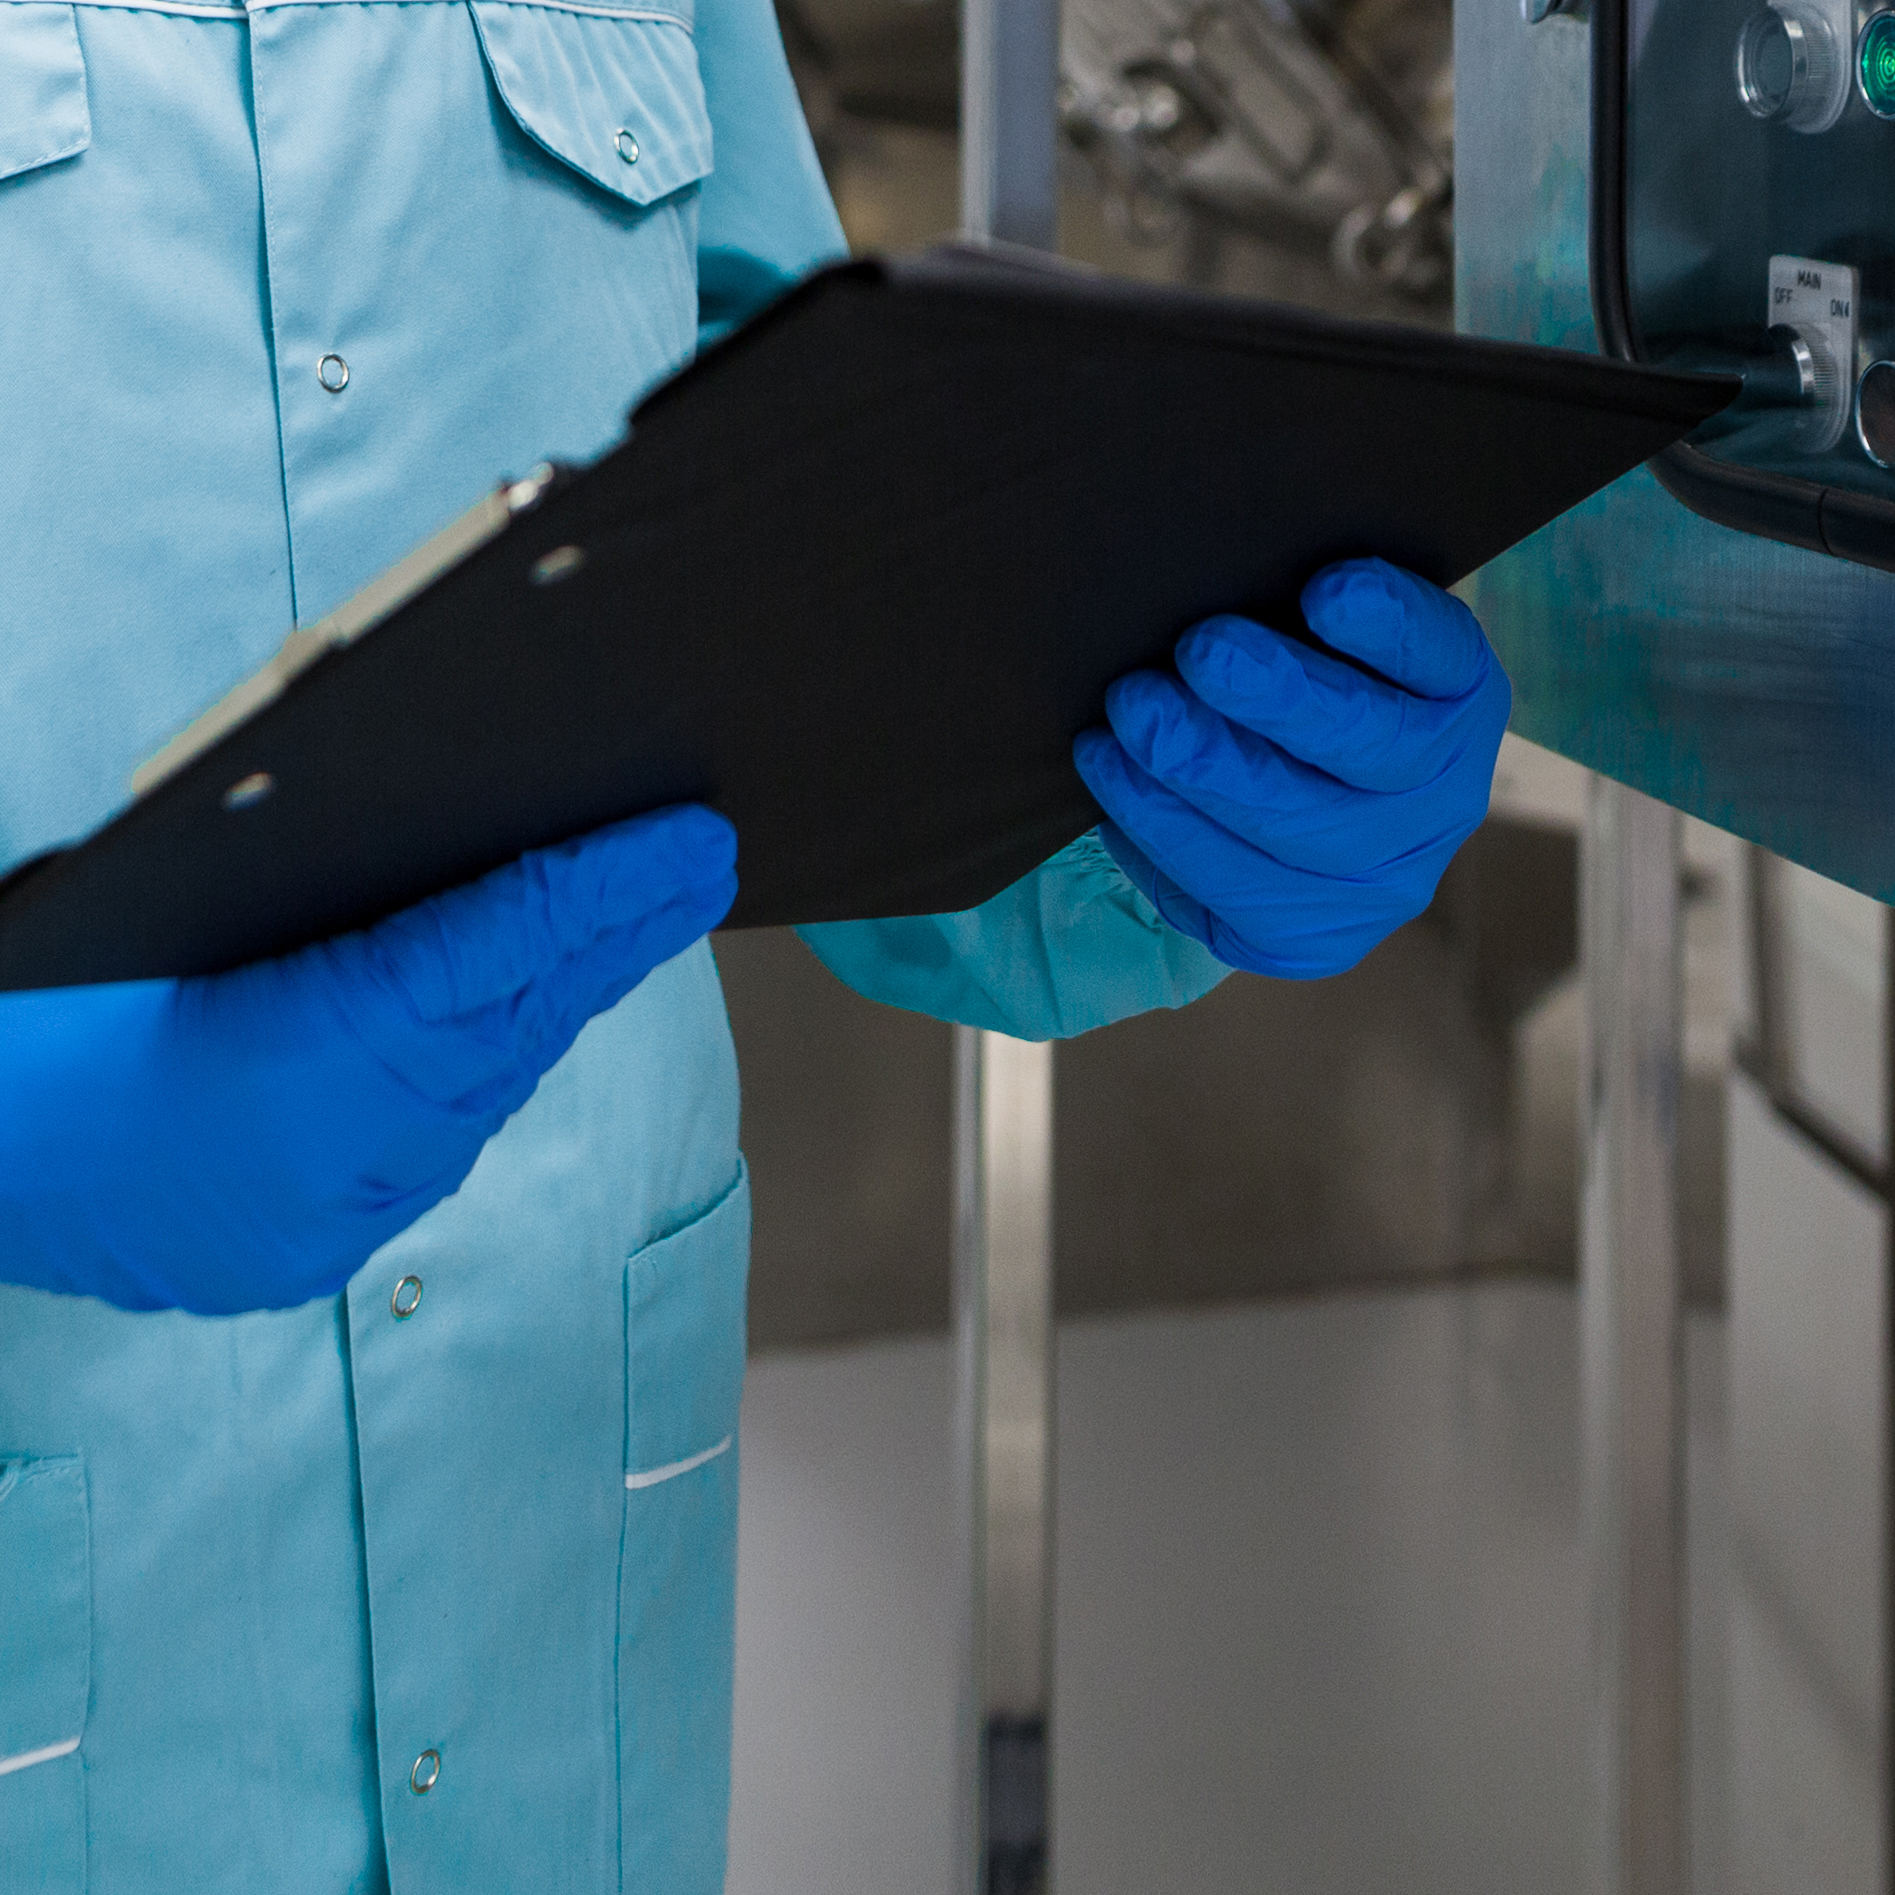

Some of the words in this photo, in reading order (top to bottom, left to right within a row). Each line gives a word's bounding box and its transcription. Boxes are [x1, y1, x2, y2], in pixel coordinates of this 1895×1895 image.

[1797, 270, 1822, 290] MAIN
[1774, 286, 1793, 304] OFF
[1830, 299, 1843, 317] ON
